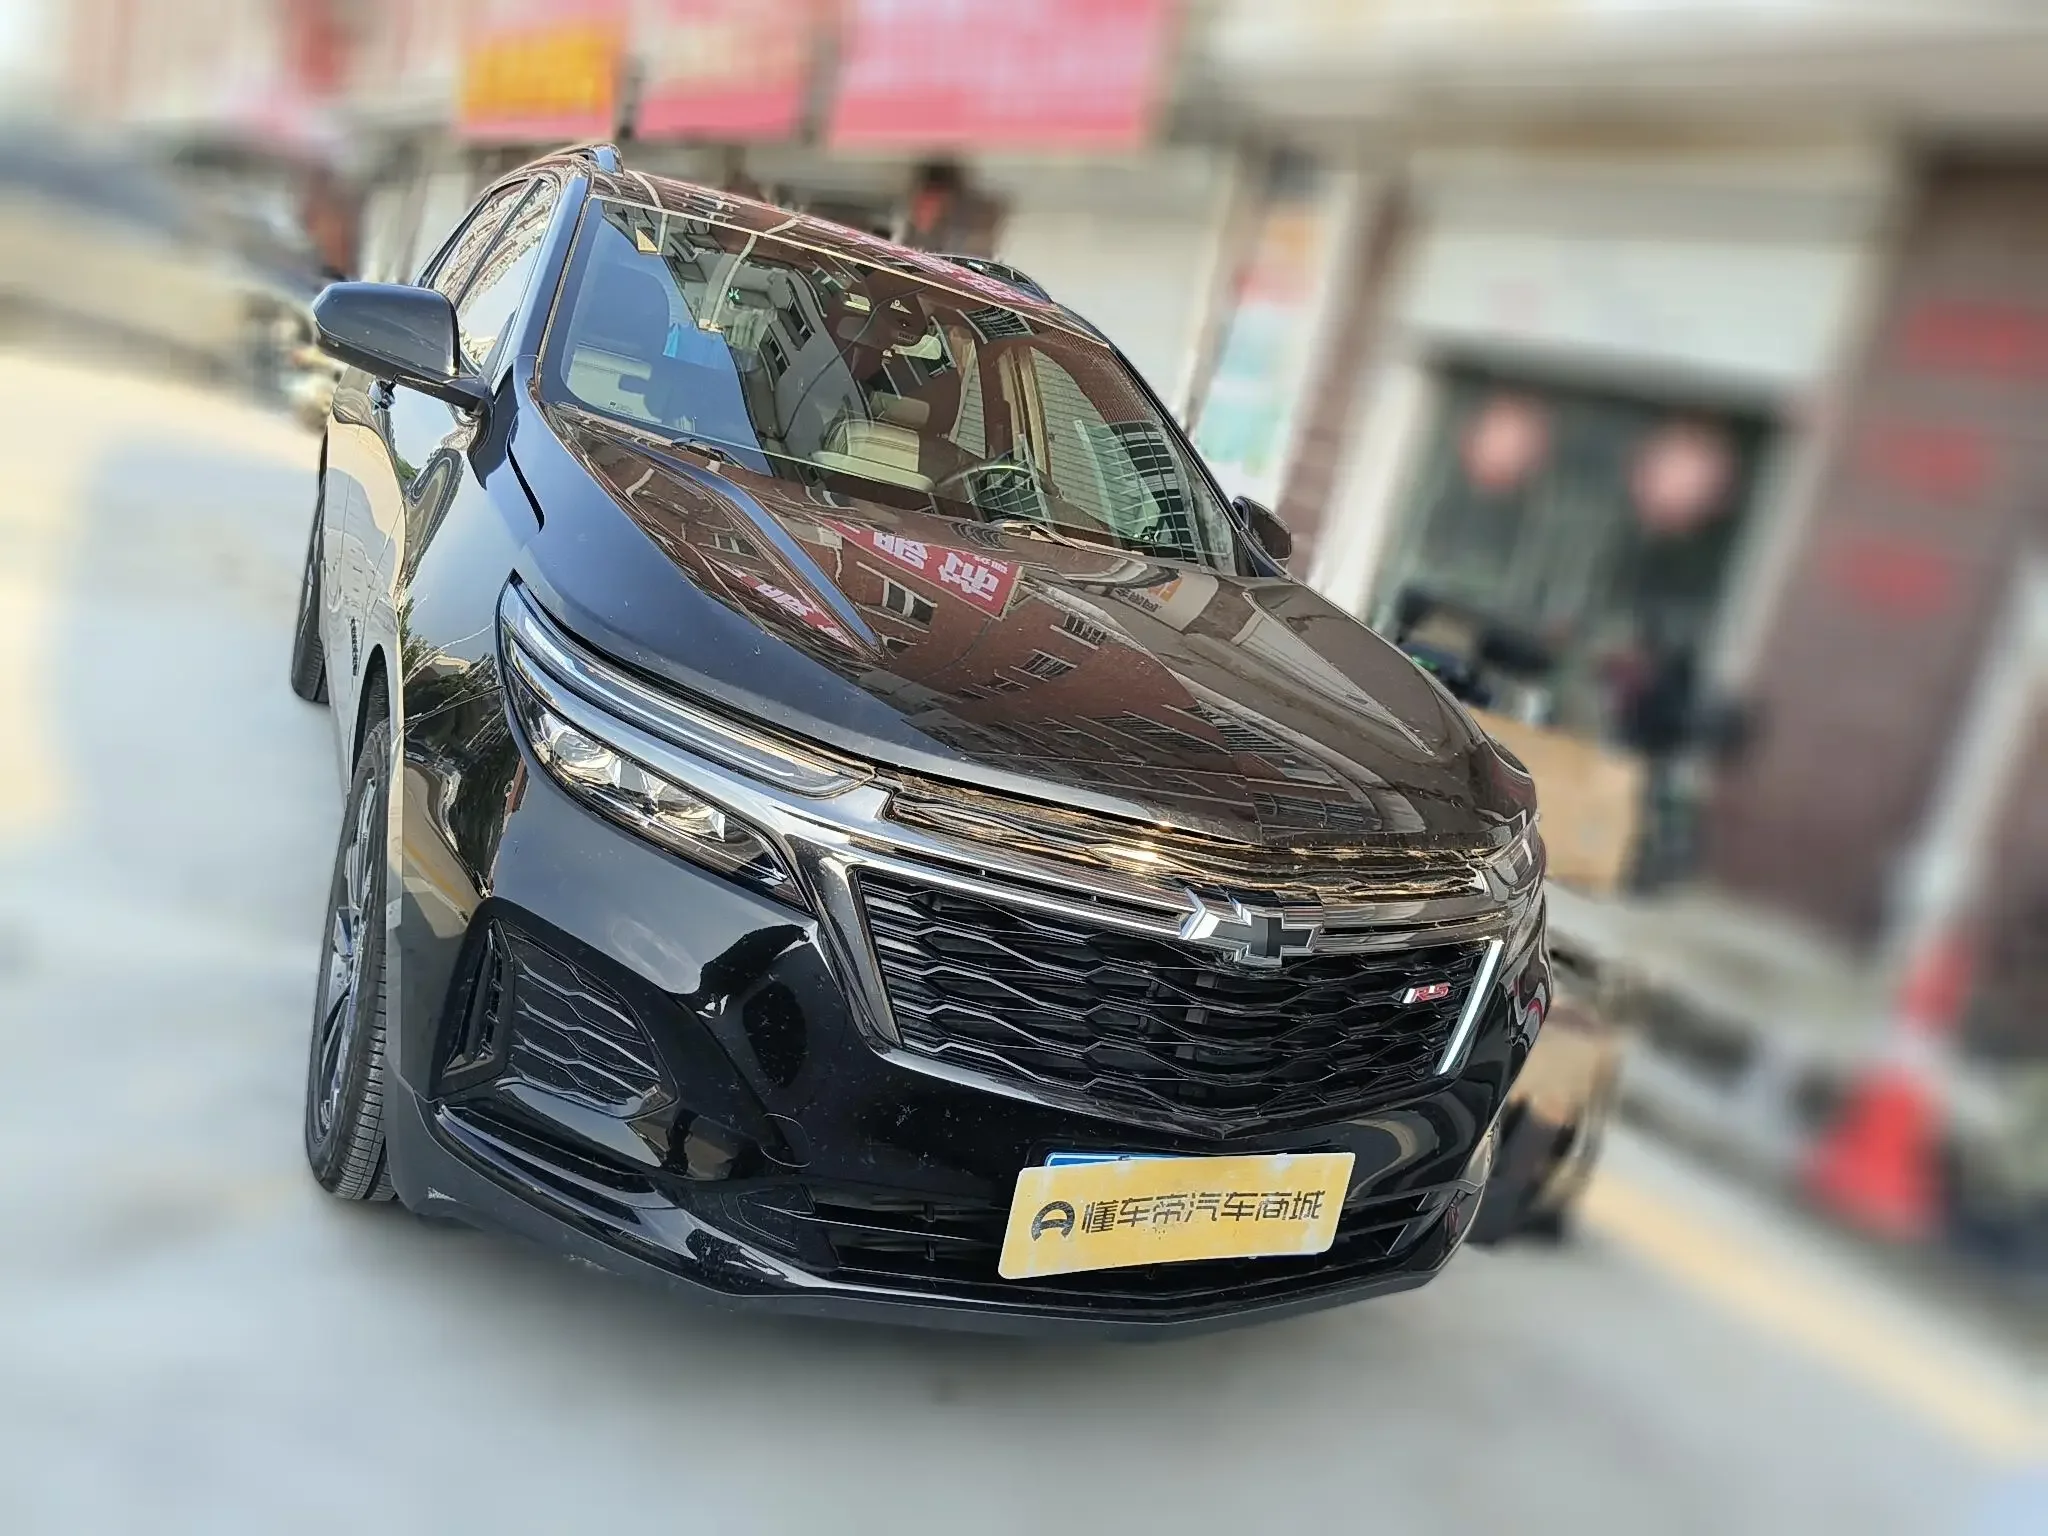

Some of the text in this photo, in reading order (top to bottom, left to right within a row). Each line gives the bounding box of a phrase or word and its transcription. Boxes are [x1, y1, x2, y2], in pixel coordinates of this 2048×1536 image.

[1405, 982, 1450, 1003] RS
[1081, 1189, 1326, 1234] 懂车帝汽车商城
